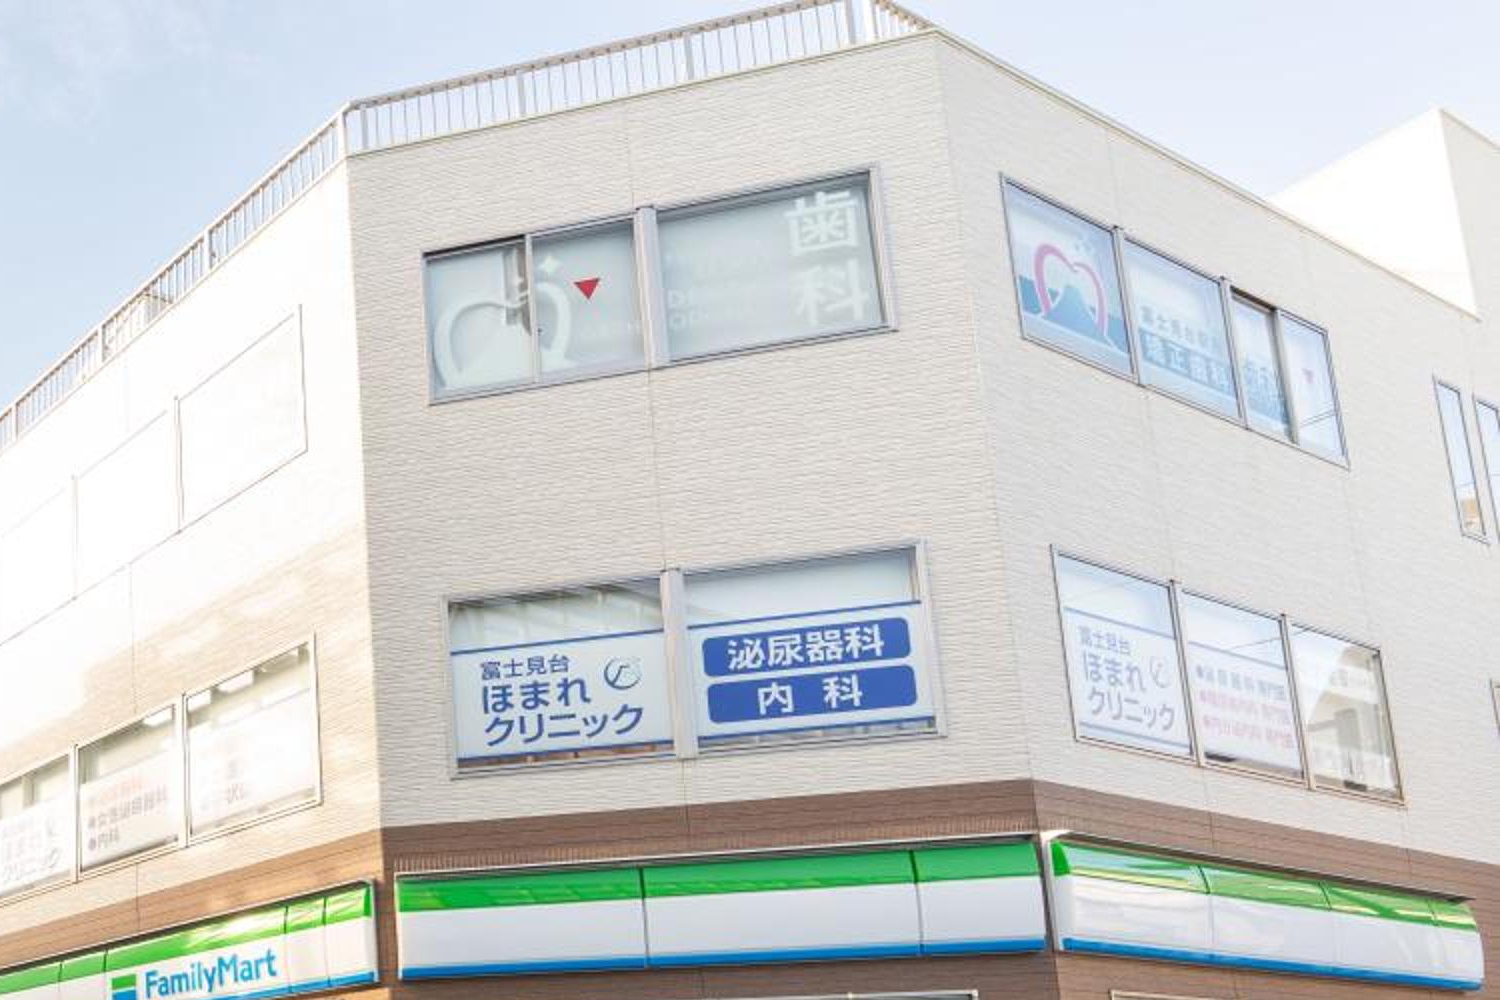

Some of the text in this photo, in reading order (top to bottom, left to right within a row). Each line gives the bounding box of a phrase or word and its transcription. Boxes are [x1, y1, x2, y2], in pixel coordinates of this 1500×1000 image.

[786, 190, 870, 326] 歯科
[480, 653, 570, 681] 富士見台
[727, 624, 884, 671] 泌尿器科
[1083, 649, 1147, 693] ほまれ
[482, 676, 591, 715] ほまれ
[758, 677, 863, 716] 内科
[1087, 686, 1175, 731] クリニック
[484, 703, 644, 747] クリニック
[145, 949, 278, 1000] FamilyMart
